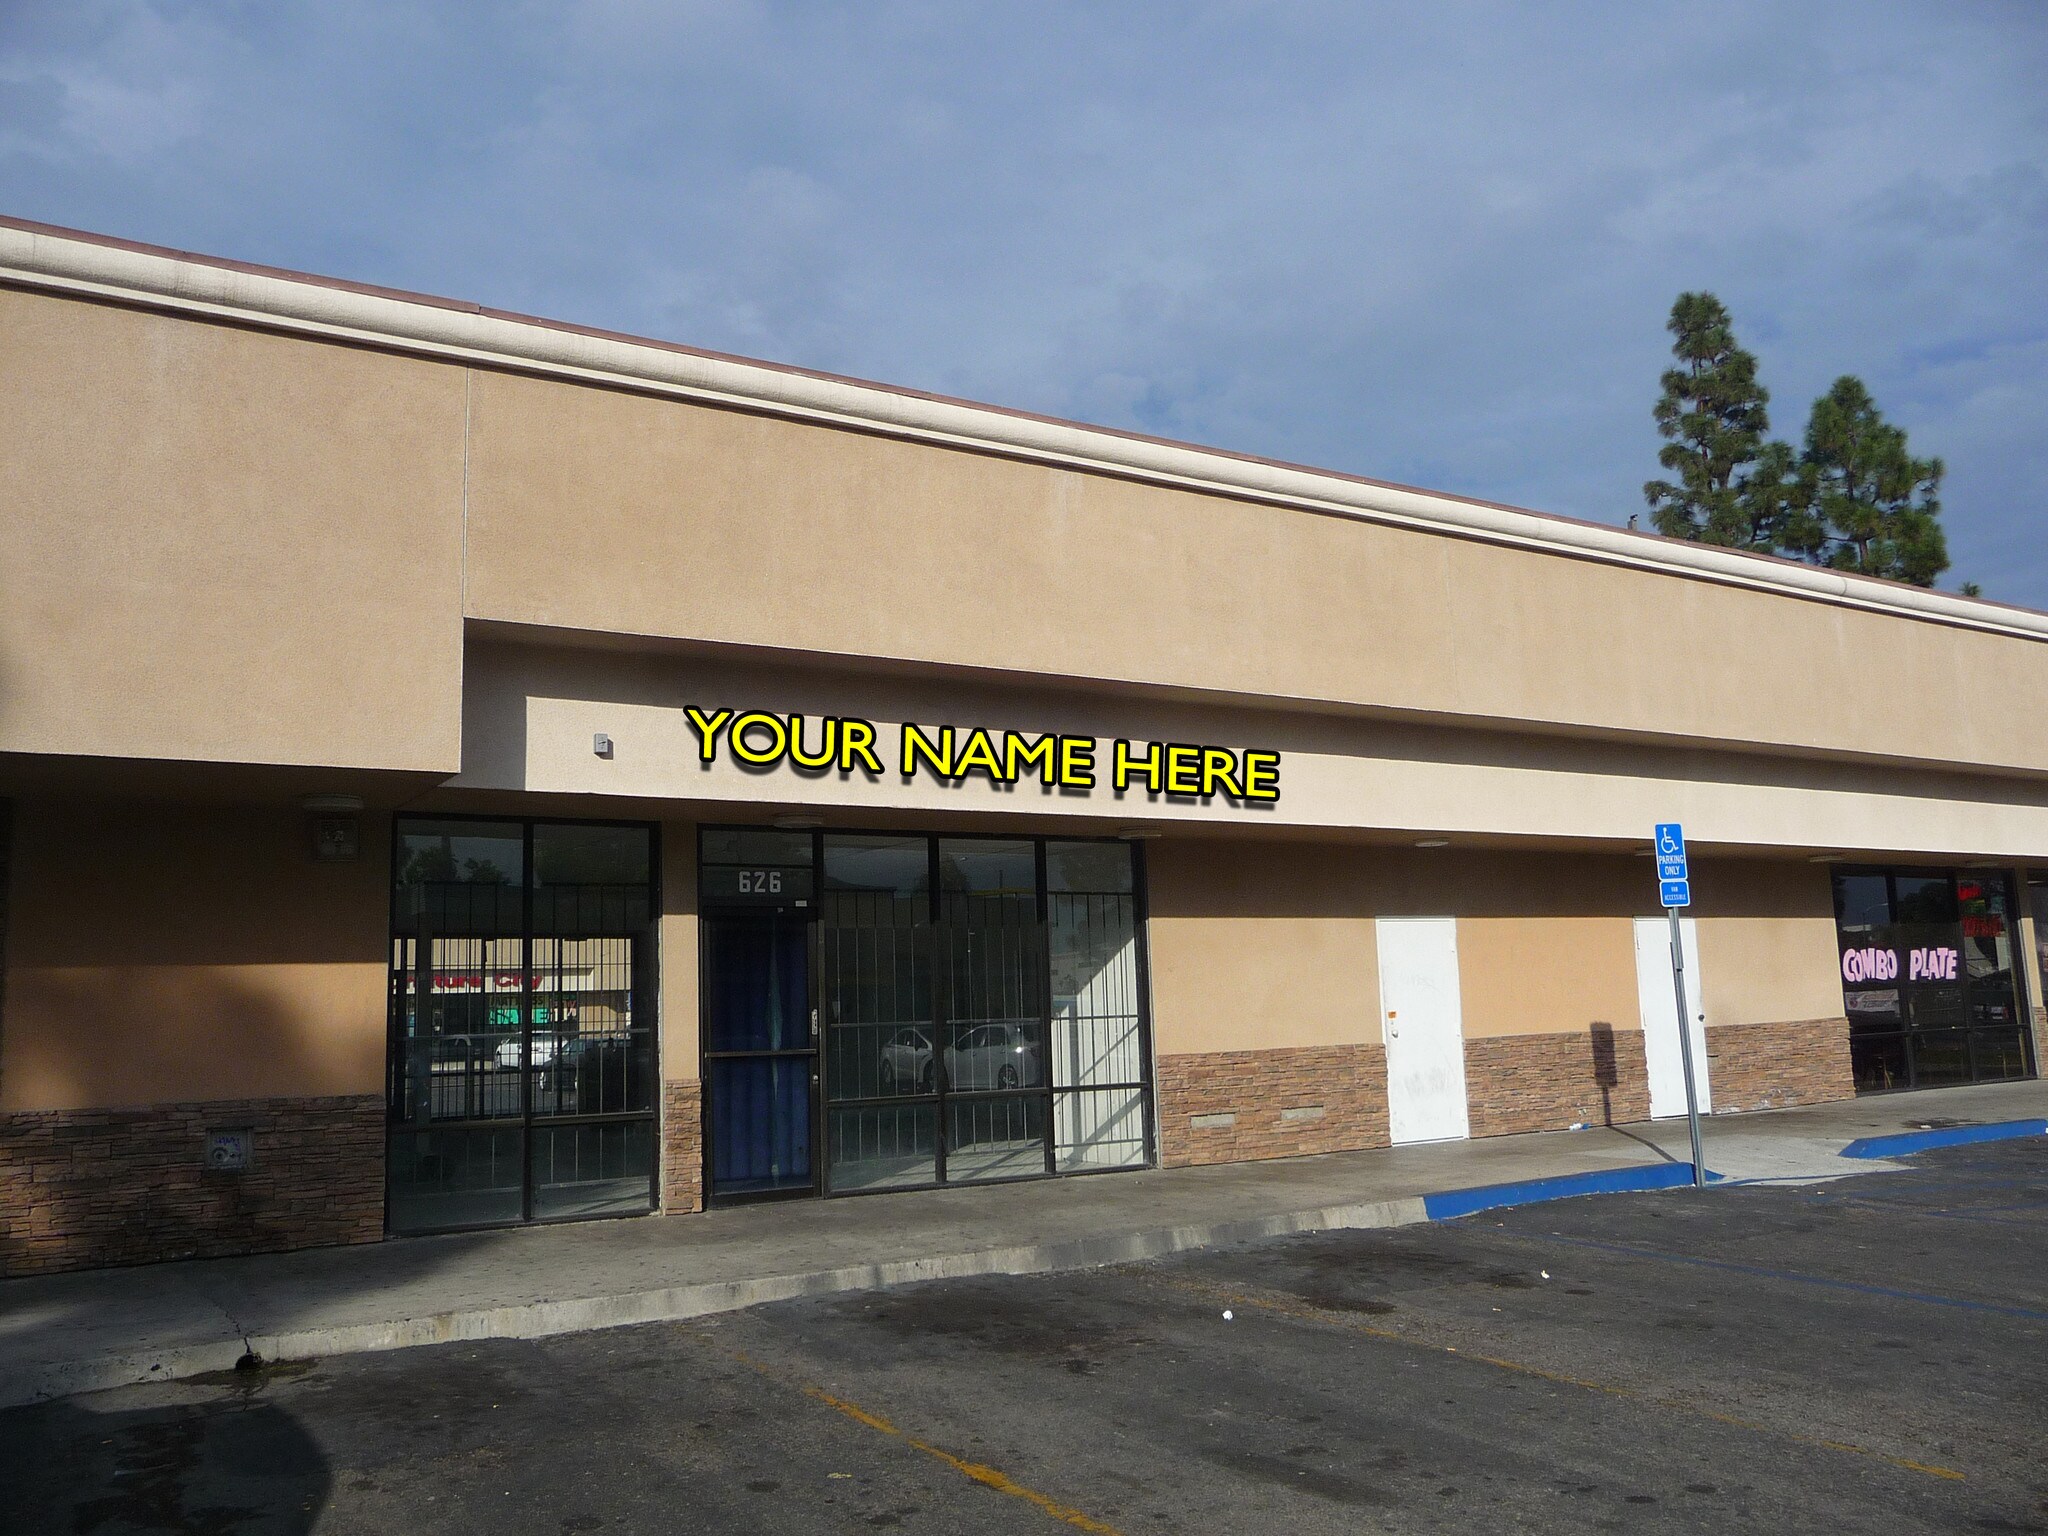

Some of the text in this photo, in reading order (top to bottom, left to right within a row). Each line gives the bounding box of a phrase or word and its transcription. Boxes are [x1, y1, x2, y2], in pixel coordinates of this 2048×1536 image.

[1659, 855, 1684, 864] PARKING
[1665, 866, 1680, 875] ONLY
[739, 871, 781, 892] 626
[1842, 948, 1957, 982] COMBO PLATE
[489, 1007, 549, 1024] SAE
